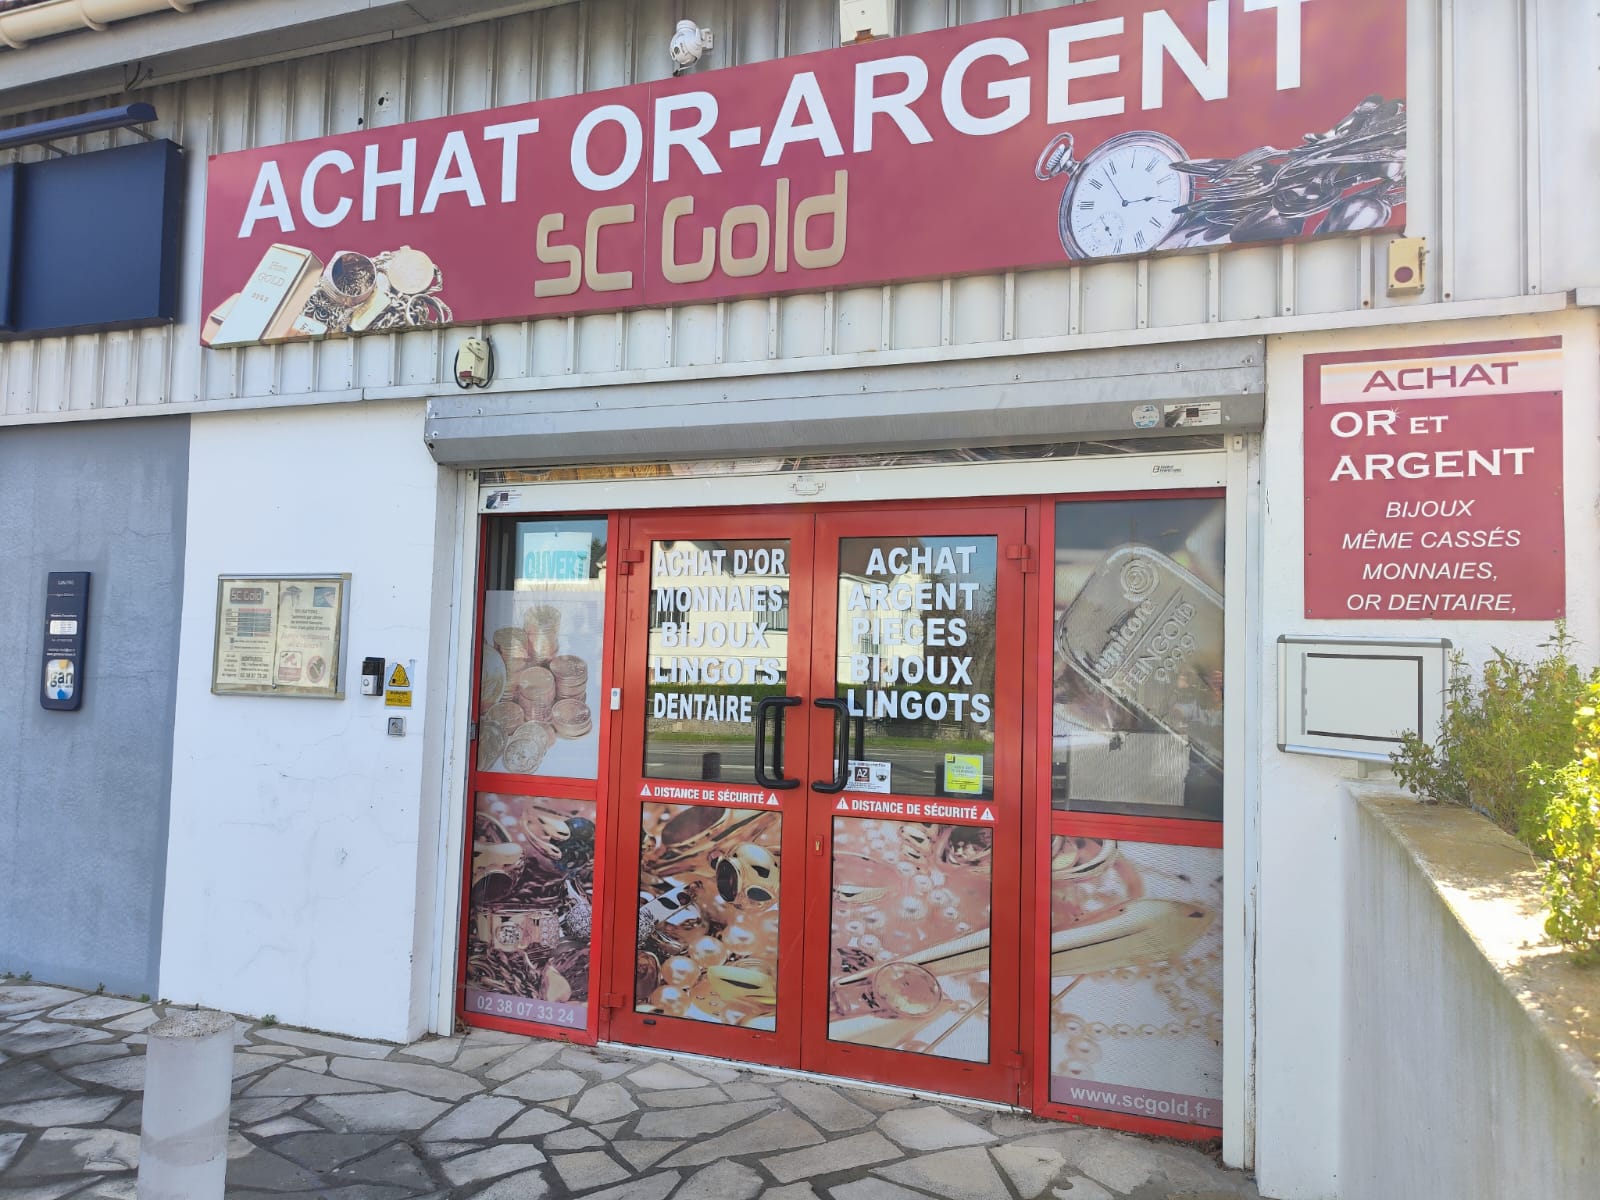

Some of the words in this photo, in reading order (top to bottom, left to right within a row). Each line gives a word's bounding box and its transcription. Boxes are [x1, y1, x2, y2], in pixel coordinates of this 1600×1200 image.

[238, 118, 539, 238] ACHAT
[571, 0, 1312, 191] OR-ARGENT
[534, 203, 635, 298] SC
[661, 169, 849, 284] Gold
[1362, 361, 1519, 393] ACHAT
[1330, 409, 1398, 438] OR
[1409, 415, 1449, 434] ET
[1329, 447, 1535, 482] ARGENT
[1385, 500, 1476, 519] BIJOUX
[1342, 529, 1413, 550] MÊME
[1420, 526, 1521, 548] CASSÉS
[525, 550, 589, 582] OUVERT
[656, 550, 727, 577] ACHAT
[733, 548, 786, 576] D'OR
[866, 545, 977, 576] ACHAT
[1362, 561, 1498, 581] MONNAIES,
[656, 585, 783, 613] MONNAIES
[848, 582, 980, 612] ARGENT
[1346, 594, 1382, 611] OR
[1388, 593, 1517, 614] DENTAIRE,
[660, 621, 770, 649] BIJOUX
[852, 617, 968, 647] PIECES
[1124, 601, 1196, 691] FEINGOLD
[50, 671, 74, 687] gan
[654, 657, 780, 685] LINGOTS
[851, 656, 974, 686] BIJOUX
[653, 693, 752, 723] DENTAIRE
[847, 689, 991, 723] LINGOTS
[654, 786, 699, 799] DISTANCE
[702, 789, 715, 800] DE
[717, 789, 764, 804] SÉCURITÉ
[851, 799, 903, 813] DISTANCE
[906, 803, 921, 815] DE
[923, 803, 977, 819] SÉCURITÉ
[477, 995, 493, 1011] 02
[496, 998, 513, 1014] 38
[516, 1001, 533, 1017] 07
[537, 1005, 553, 1021] 33
[558, 1008, 575, 1025] 24
[1070, 1087, 1210, 1119] www.scgold.fr
